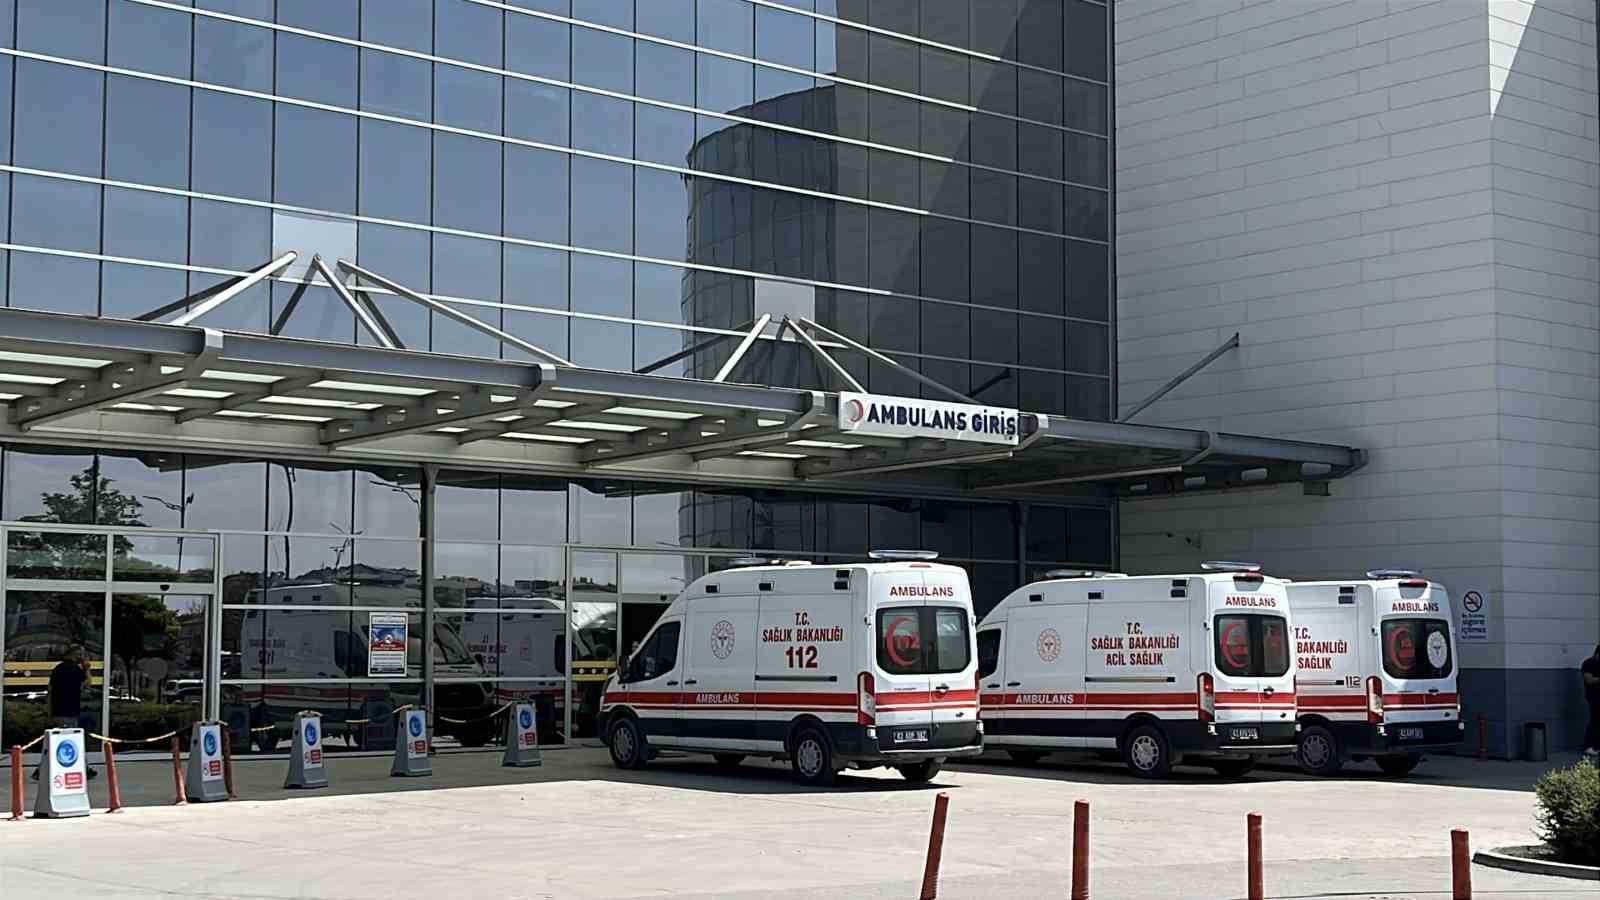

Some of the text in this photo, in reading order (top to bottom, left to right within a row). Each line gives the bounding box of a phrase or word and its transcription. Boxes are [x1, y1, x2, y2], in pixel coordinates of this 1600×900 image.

[867, 403, 1016, 440] AMBULANS GİRİŞ
[890, 586, 954, 597] AMBULANS
[1225, 596, 1276, 607] AMBULANS
[1392, 602, 1439, 612] AMBULANS
[795, 612, 810, 626] T.C.
[762, 626, 843, 643] SAĞLIK BAKANLIĞI
[1126, 623, 1143, 635] T.C.
[1295, 627, 1311, 639] T.C.
[1091, 634, 1179, 650] SAĞLIK BAKANLIĞI
[1297, 640, 1348, 654] BAKANLIĞI
[785, 645, 818, 668] 112
[1106, 651, 1163, 666] ACİL SAĞLIK
[1298, 655, 1332, 669] SAĞLIK
[1345, 676, 1361, 686] 112
[695, 693, 740, 705] AMBULANS
[1015, 694, 1074, 704] AMBULANS
